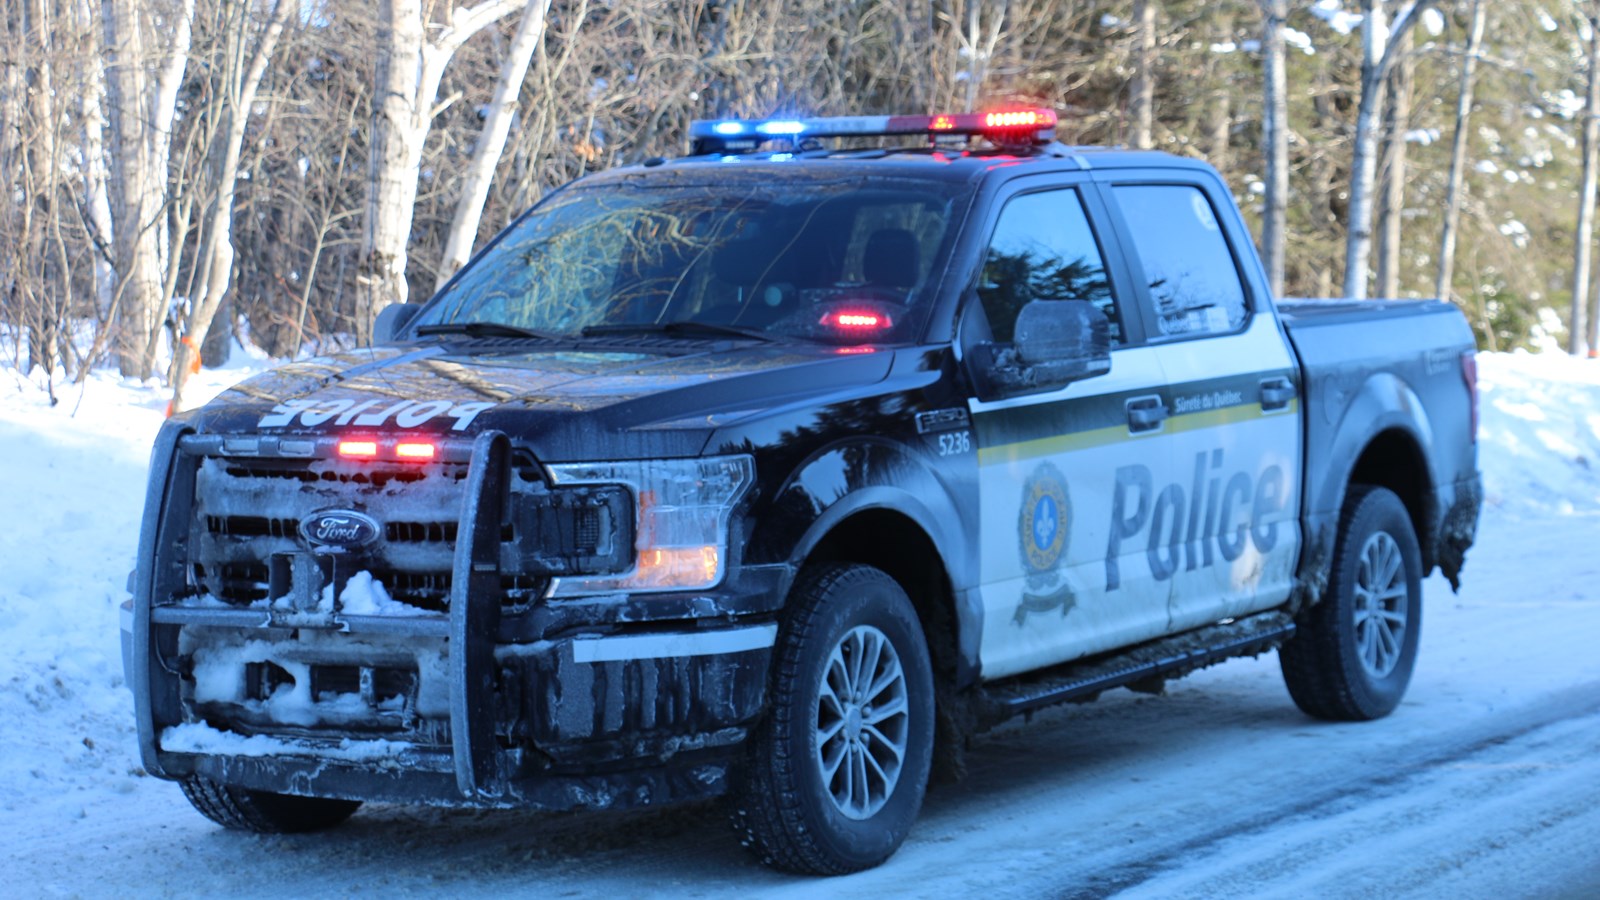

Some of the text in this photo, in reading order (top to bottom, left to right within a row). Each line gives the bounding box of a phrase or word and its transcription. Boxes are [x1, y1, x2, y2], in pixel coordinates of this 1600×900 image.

[1175, 390, 1242, 413] Sûreté du Québec
[939, 431, 970, 456] 5236
[317, 517, 360, 540] Ford
[1106, 448, 1284, 592] Police
